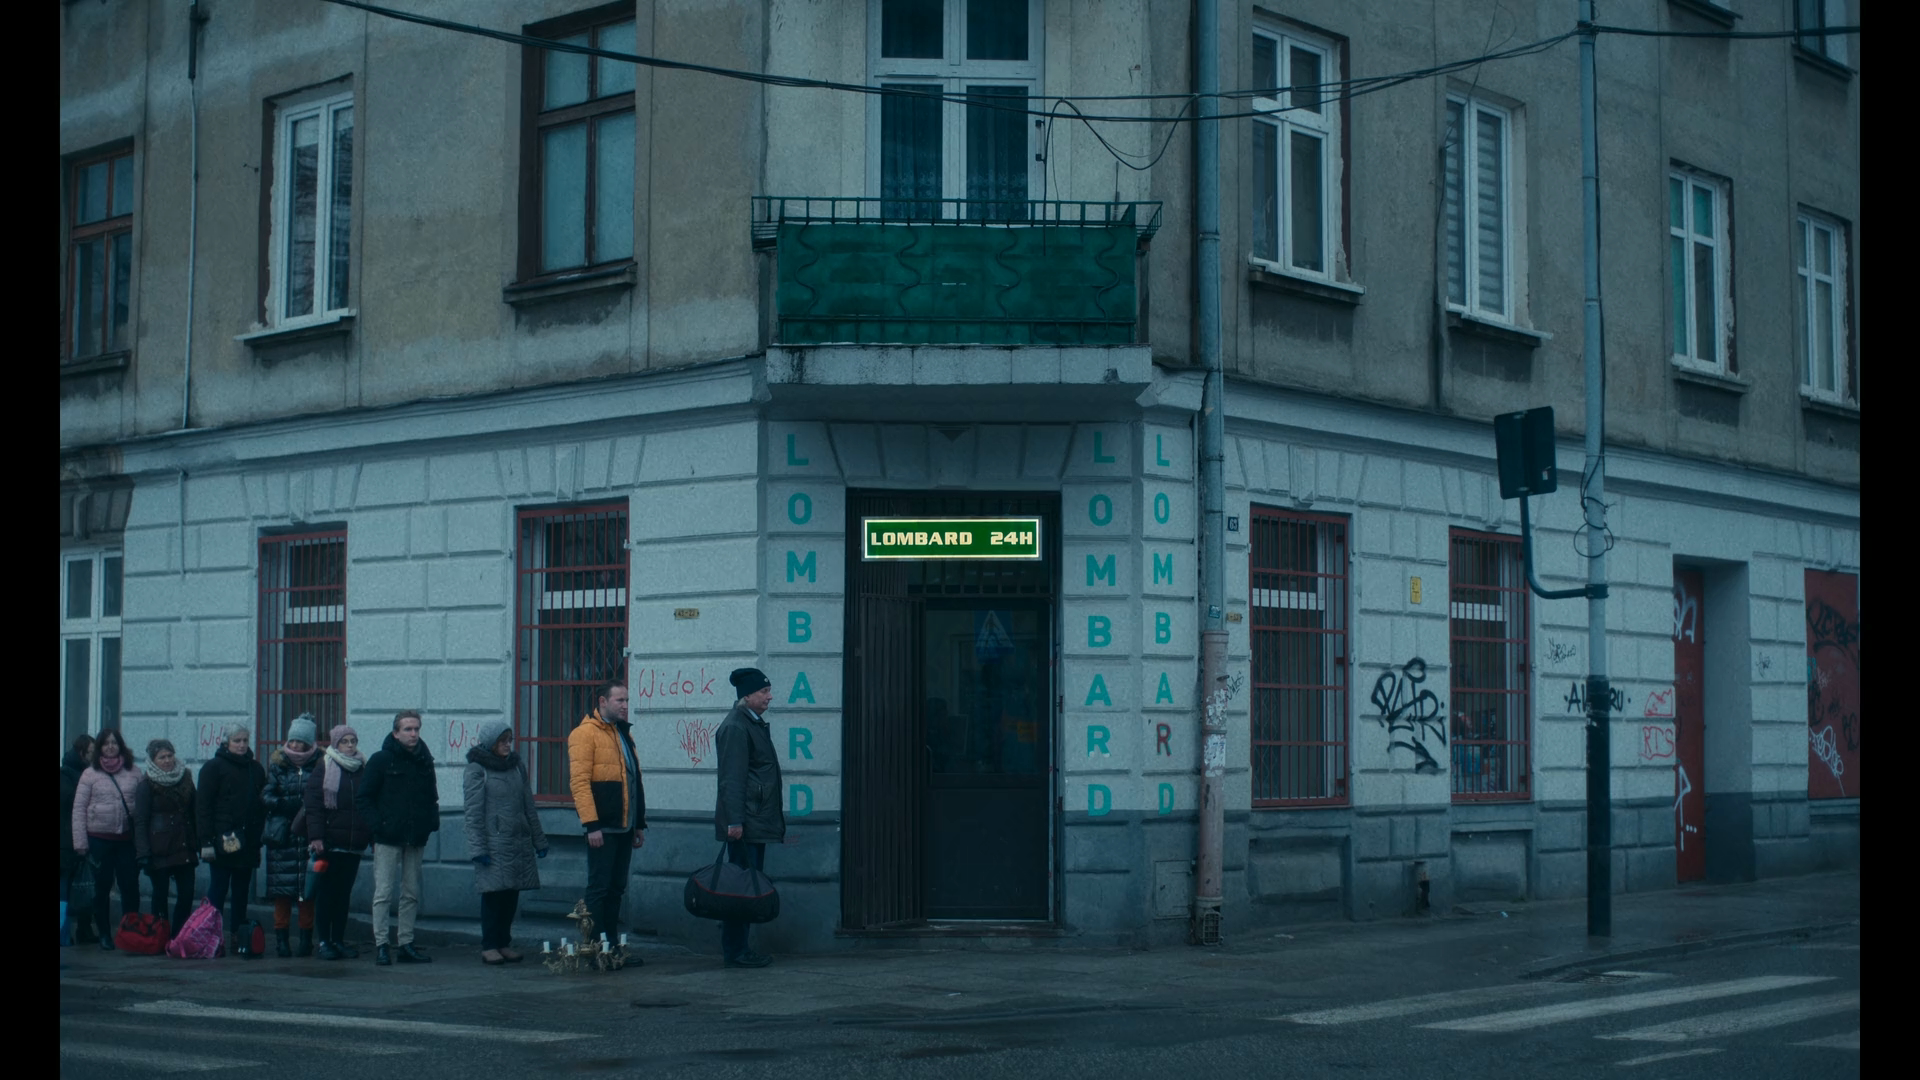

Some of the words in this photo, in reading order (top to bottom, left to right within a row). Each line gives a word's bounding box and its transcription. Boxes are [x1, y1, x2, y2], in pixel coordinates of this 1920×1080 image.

[639, 667, 715, 698] Widok
[785, 433, 817, 819] LOMBARD
[870, 531, 973, 546] LOMBARD
[990, 531, 1033, 546] 24H
[1085, 429, 1117, 817] LOMBARD
[1153, 432, 1175, 817] LOMBARD
